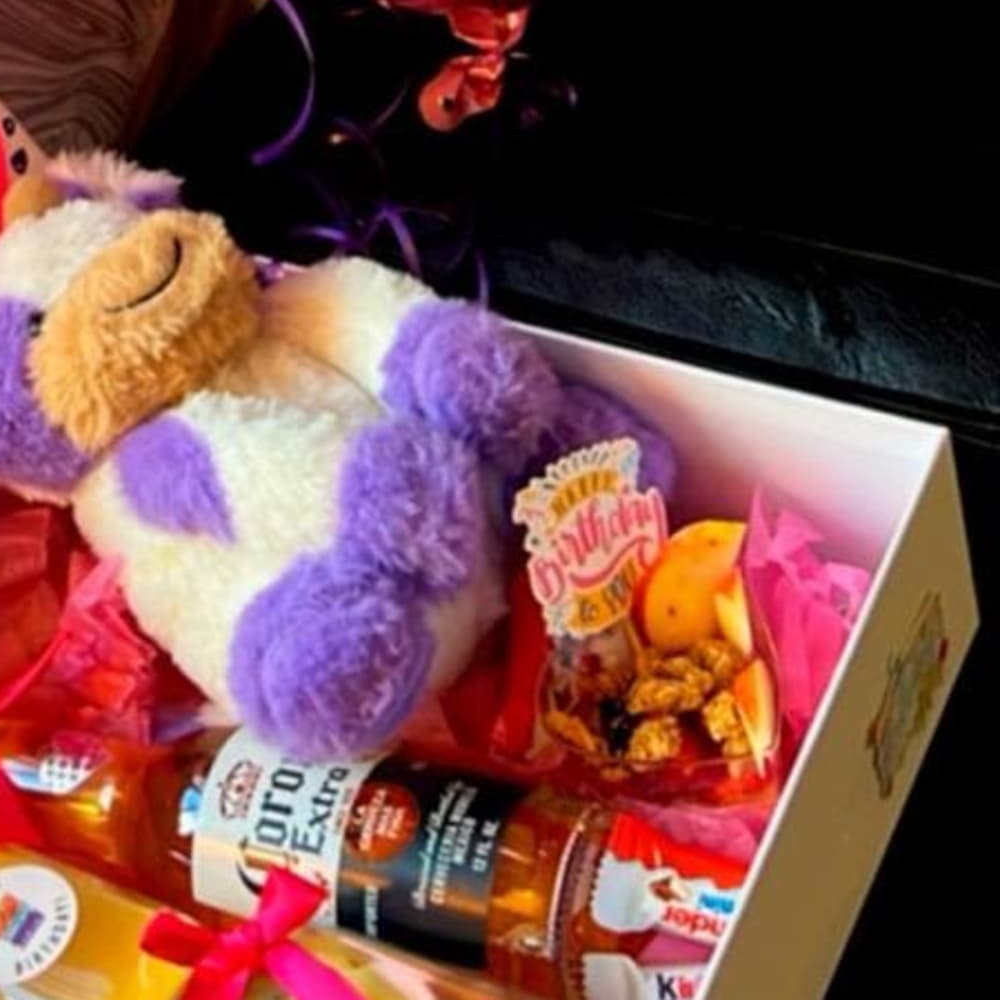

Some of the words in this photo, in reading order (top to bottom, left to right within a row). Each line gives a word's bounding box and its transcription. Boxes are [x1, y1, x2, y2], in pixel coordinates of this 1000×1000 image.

[236, 757, 316, 895] Coro
[291, 766, 351, 856] Extra
[660, 904, 727, 942] nder
